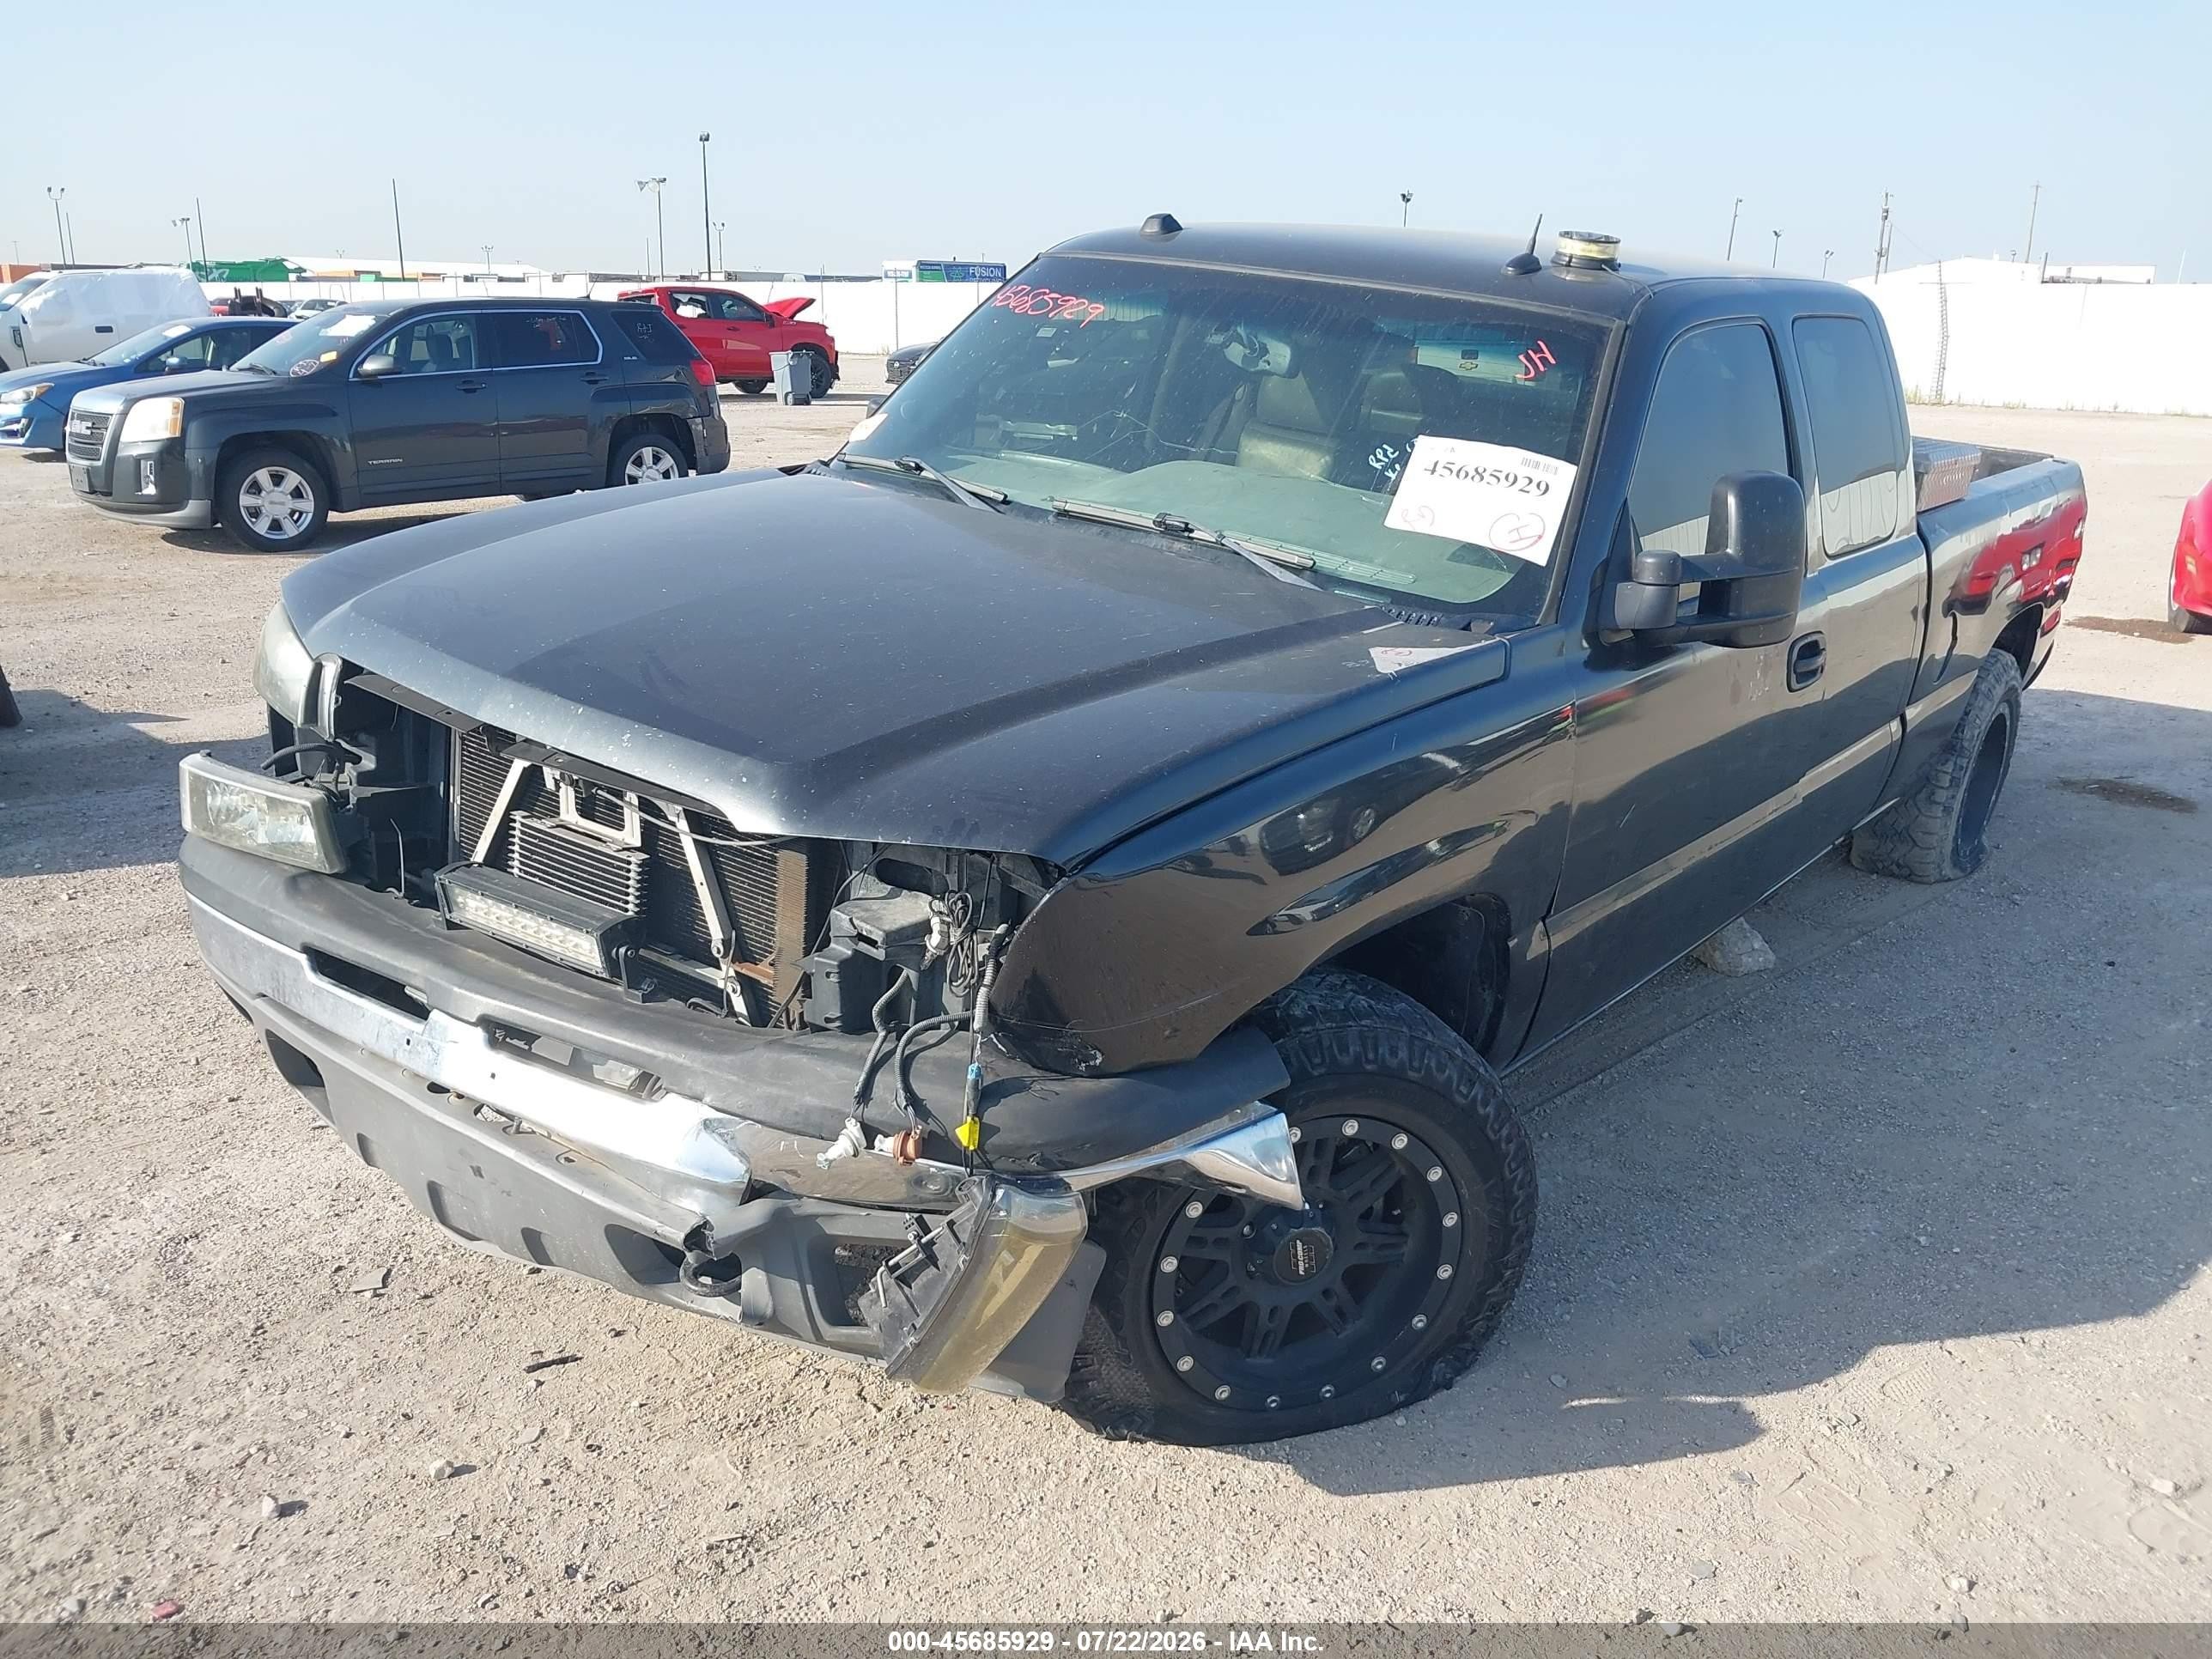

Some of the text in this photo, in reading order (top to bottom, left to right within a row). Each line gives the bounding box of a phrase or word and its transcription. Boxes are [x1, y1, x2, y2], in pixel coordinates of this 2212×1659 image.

[969, 266, 1002, 277] FUSION
[1514, 340, 1556, 379] JH
[1423, 459, 1551, 497] 45685929
